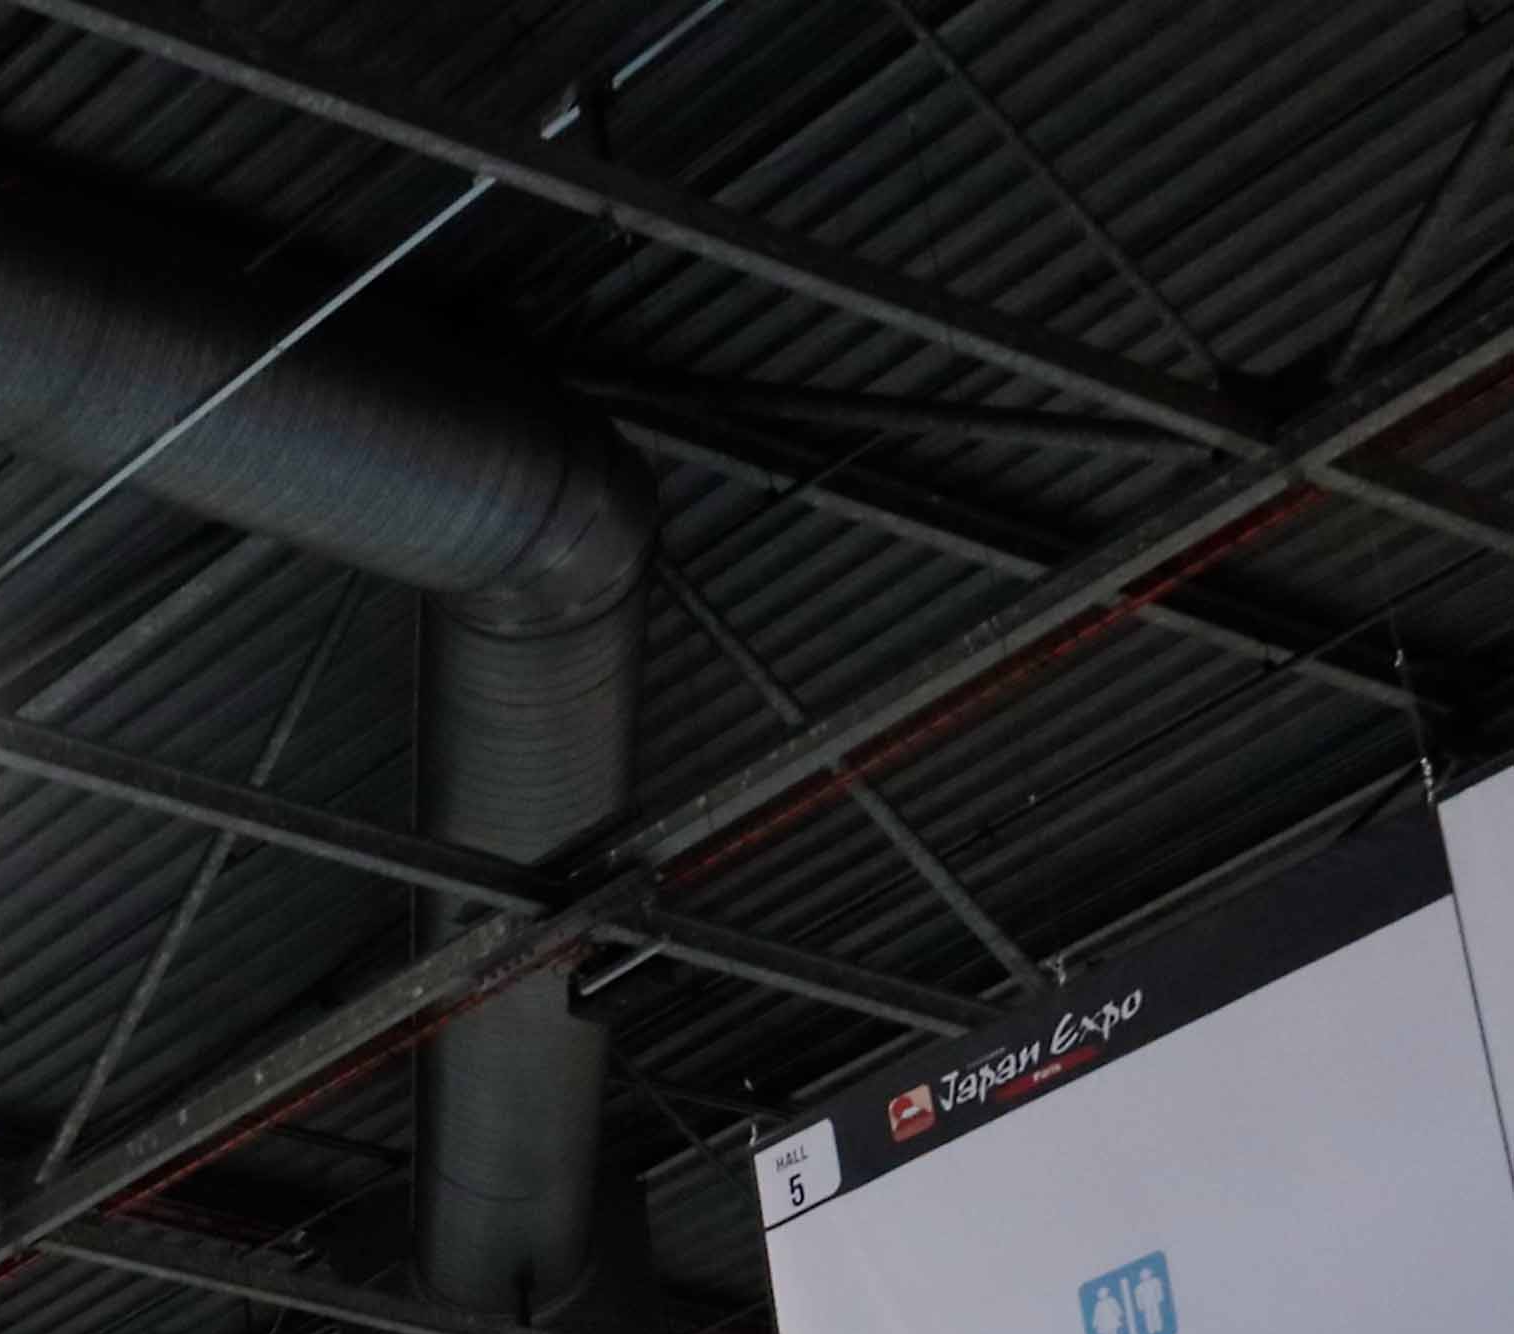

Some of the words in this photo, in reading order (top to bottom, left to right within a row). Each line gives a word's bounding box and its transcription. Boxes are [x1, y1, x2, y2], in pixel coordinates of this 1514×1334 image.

[939, 1040, 1040, 1111] Japan
[1049, 988, 1143, 1054] Expo
[775, 1144, 809, 1172] HALL
[788, 1173, 806, 1207] 5
